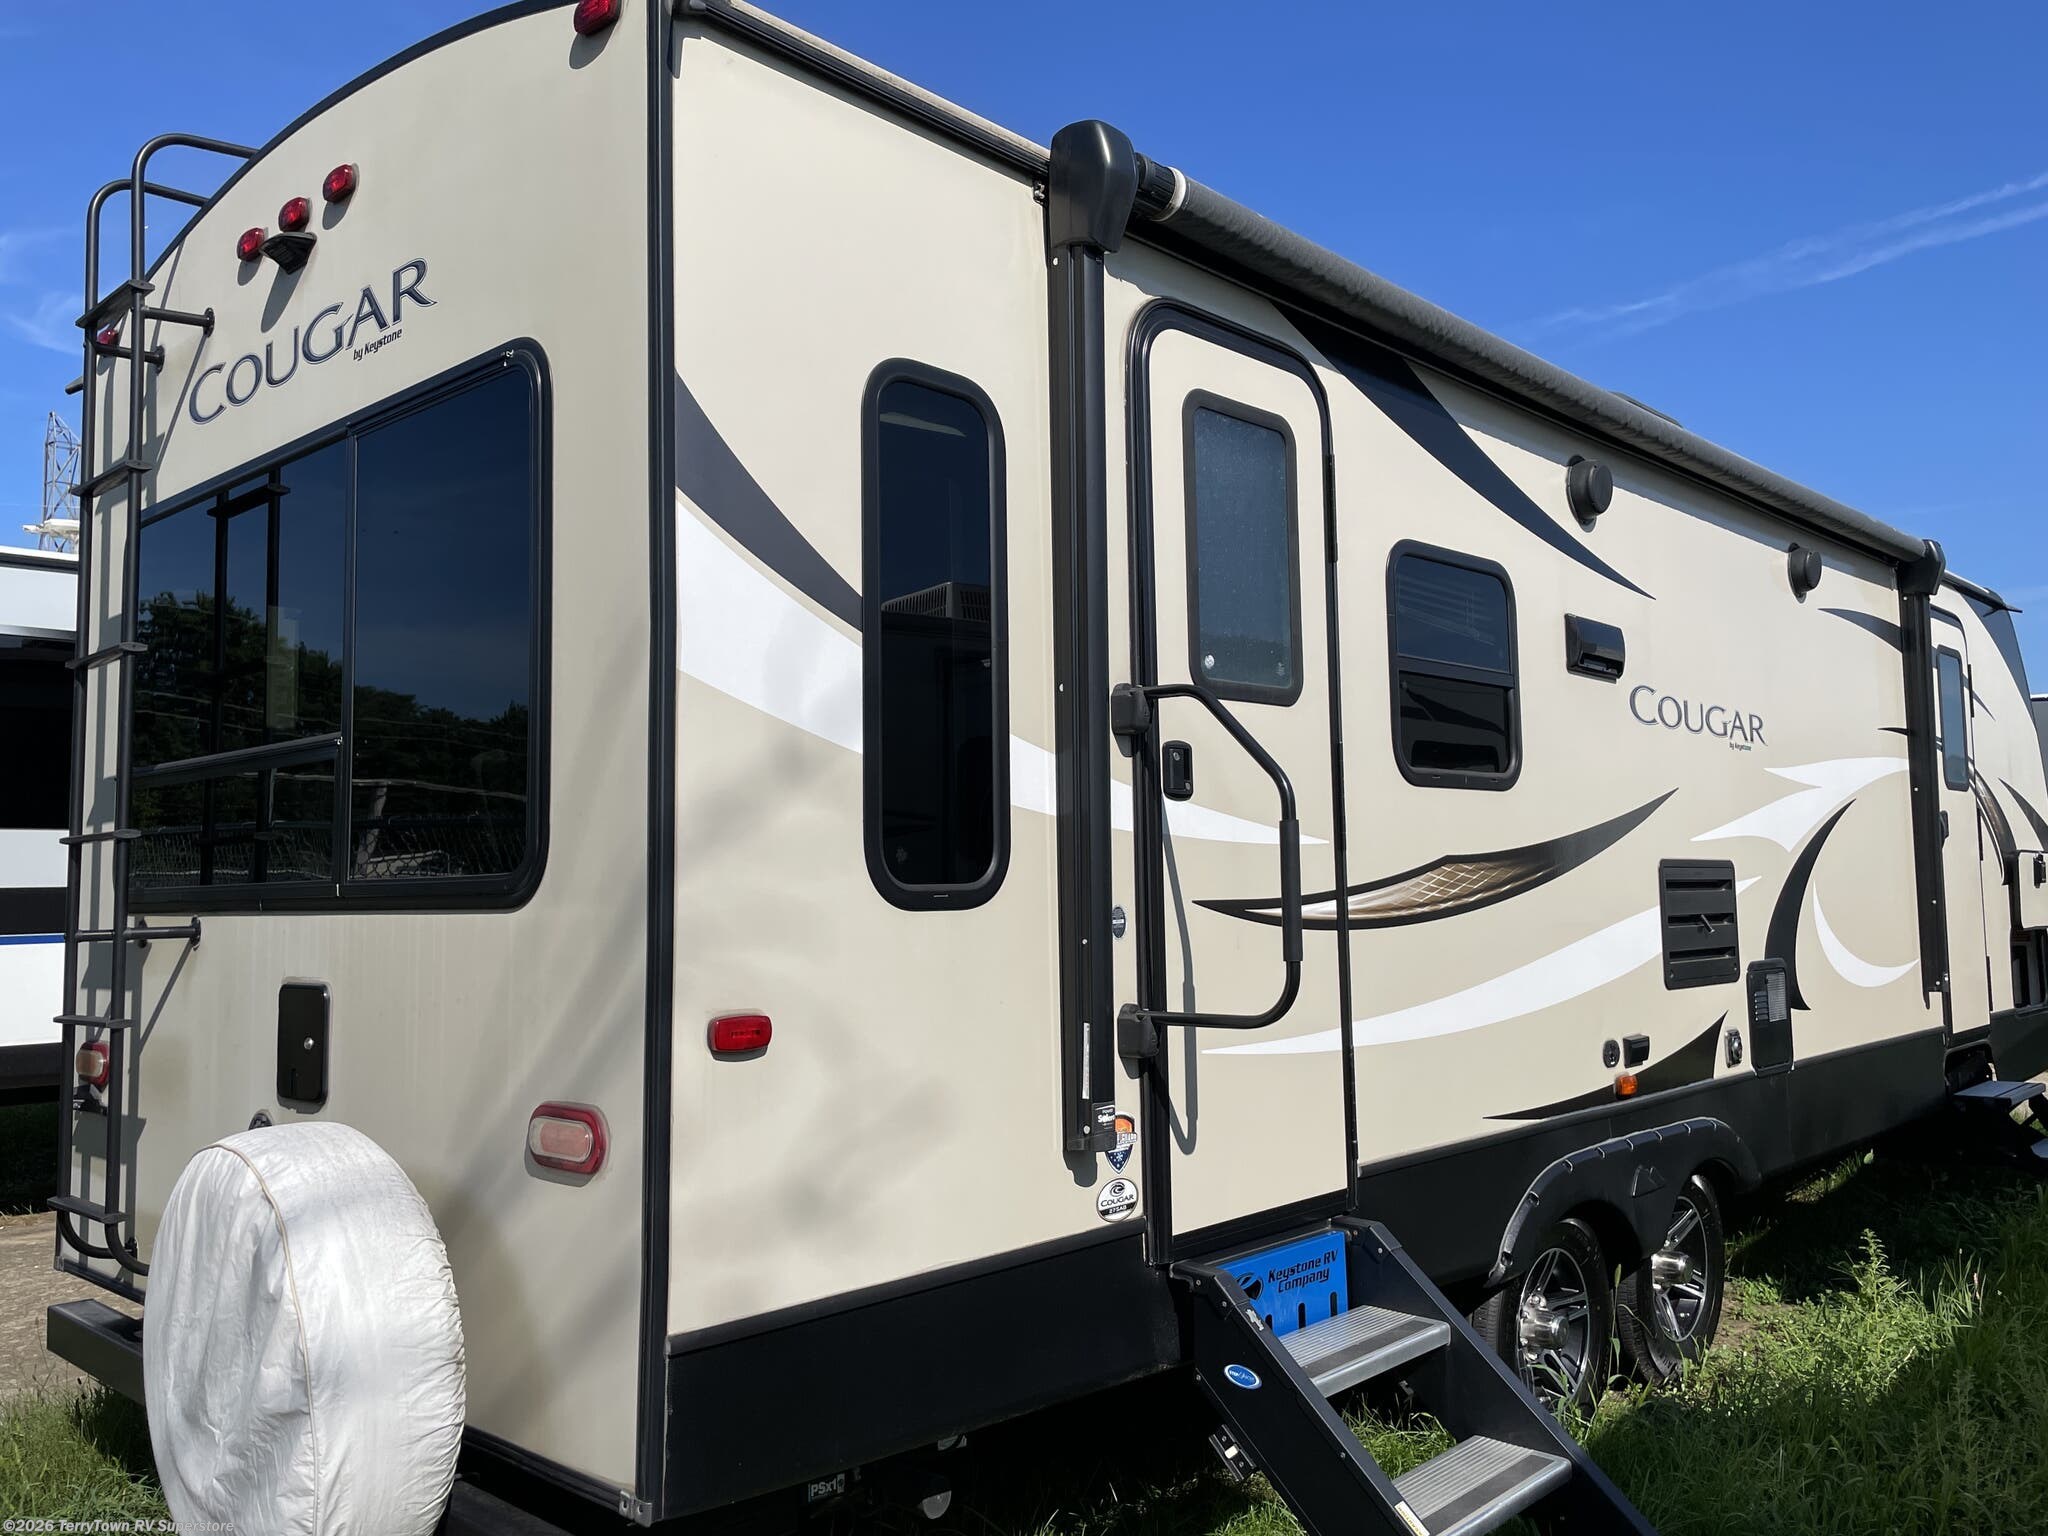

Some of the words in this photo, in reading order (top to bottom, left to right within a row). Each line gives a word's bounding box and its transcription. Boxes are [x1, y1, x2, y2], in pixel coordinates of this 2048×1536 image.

[188, 257, 438, 425] COUGAR
[353, 348, 364, 361] by
[364, 328, 402, 356] Keystone
[1629, 685, 1768, 747] COUGAR
[1100, 1194, 1134, 1207] COUGAR
[1268, 1257, 1321, 1284] Keystone
[1323, 1248, 1339, 1265] RV
[1278, 1268, 1330, 1293] Company
